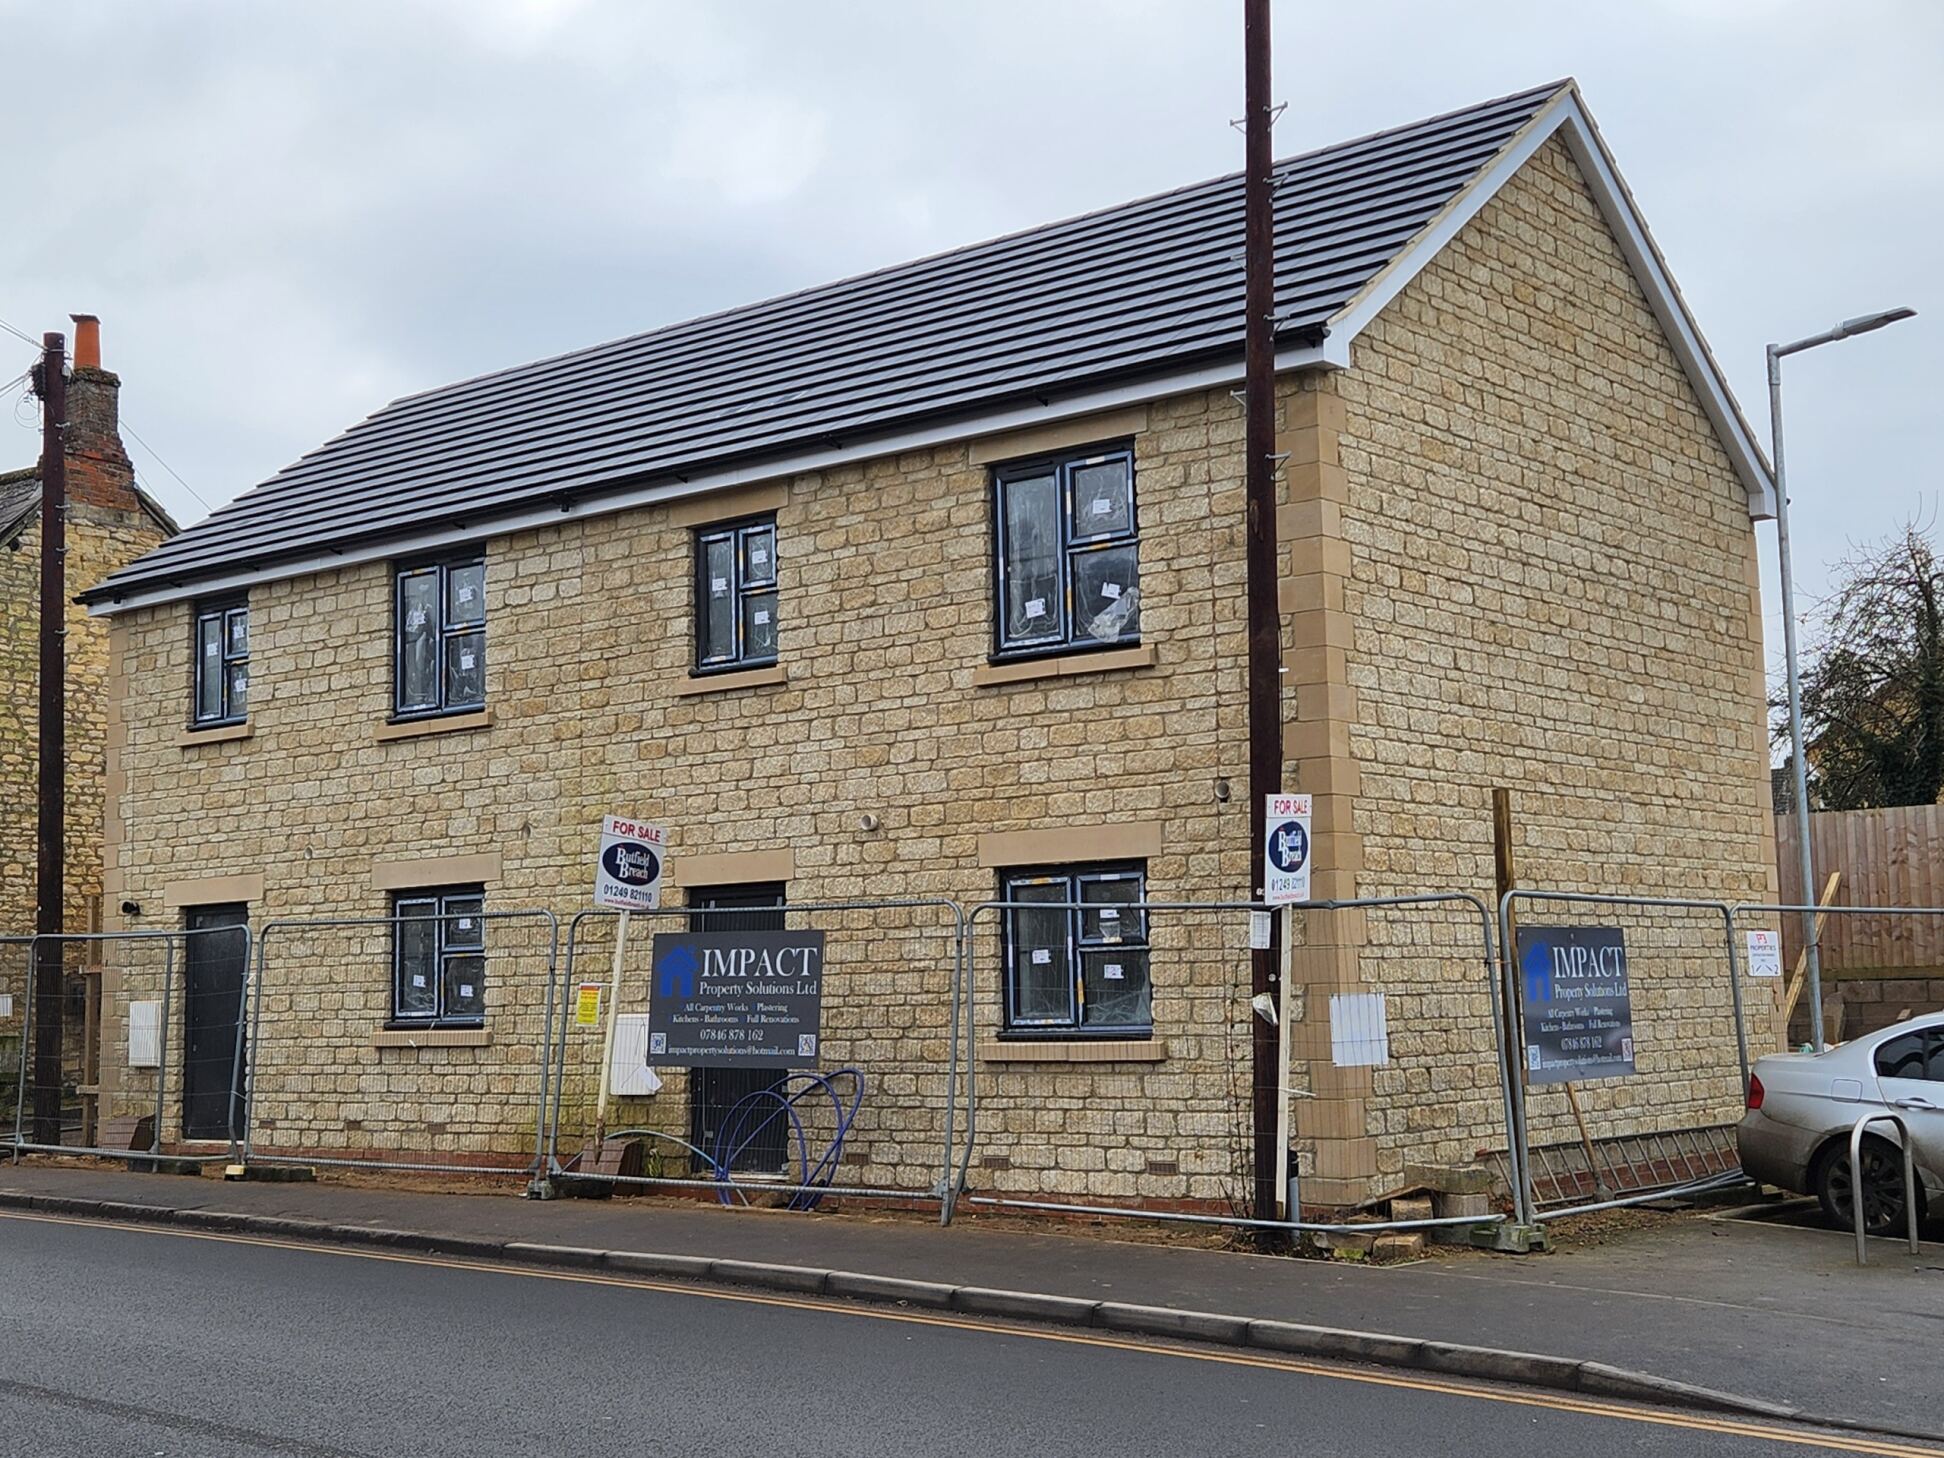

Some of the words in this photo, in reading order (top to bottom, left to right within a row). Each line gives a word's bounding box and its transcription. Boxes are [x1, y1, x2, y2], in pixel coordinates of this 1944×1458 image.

[1274, 800, 1291, 815] FOR
[1293, 800, 1308, 814] SALE
[612, 820, 636, 837] FOR
[637, 826, 661, 843] SALE
[615, 847, 650, 868] Butfield
[618, 862, 648, 880] Breach
[603, 883, 629, 898] 01249
[629, 888, 653, 903] 821110
[1271, 878, 1290, 891] 01249
[701, 947, 818, 977] IMPACT
[1552, 946, 1624, 978] IMPACT
[699, 981, 743, 997] Property
[745, 980, 794, 995] Solutions
[796, 980, 817, 995] Ltd
[1554, 983, 1583, 1001] Property
[1584, 982, 1615, 998] Solutions
[1614, 982, 1627, 997] Ltd
[685, 1003, 694, 1012] All
[695, 1003, 725, 1013] Carpentry
[727, 1003, 749, 1012] Works
[757, 1003, 789, 1013] Plastering
[672, 1014, 699, 1024] Kitchens
[704, 1014, 739, 1024] Bathrooms
[746, 1014, 760, 1024] Full
[760, 1014, 800, 1024] Renovations
[700, 1029, 727, 1041] 07846
[728, 1029, 745, 1040] 878
[748, 1029, 764, 1041] 162
